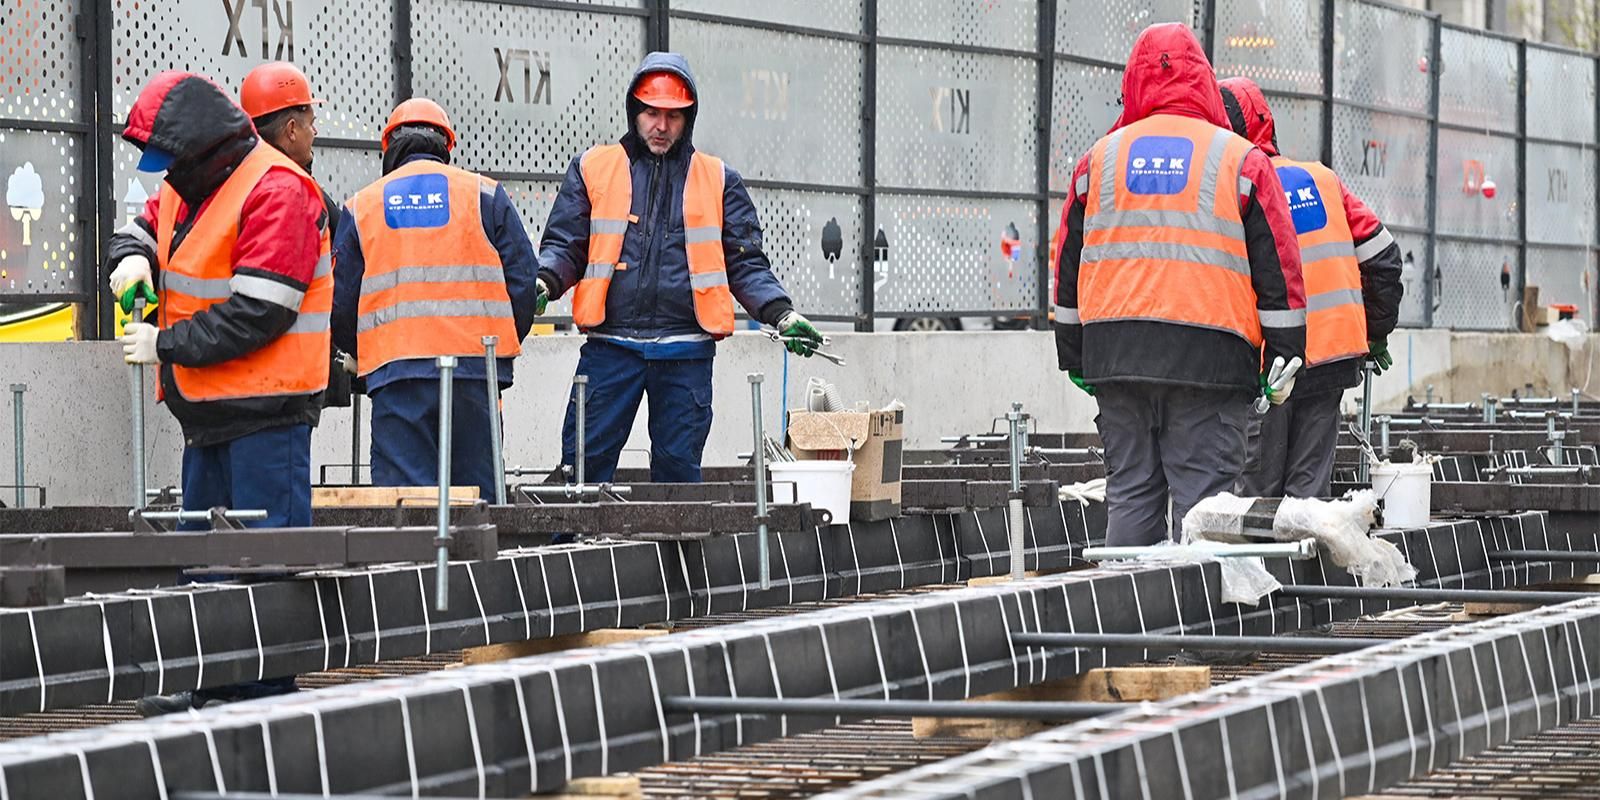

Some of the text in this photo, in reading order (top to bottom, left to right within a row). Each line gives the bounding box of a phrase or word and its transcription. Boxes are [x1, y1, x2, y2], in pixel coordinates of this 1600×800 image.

[1132, 157, 1185, 170] СТК
[389, 193, 443, 206] СТК
[1284, 187, 1315, 205] ТК
